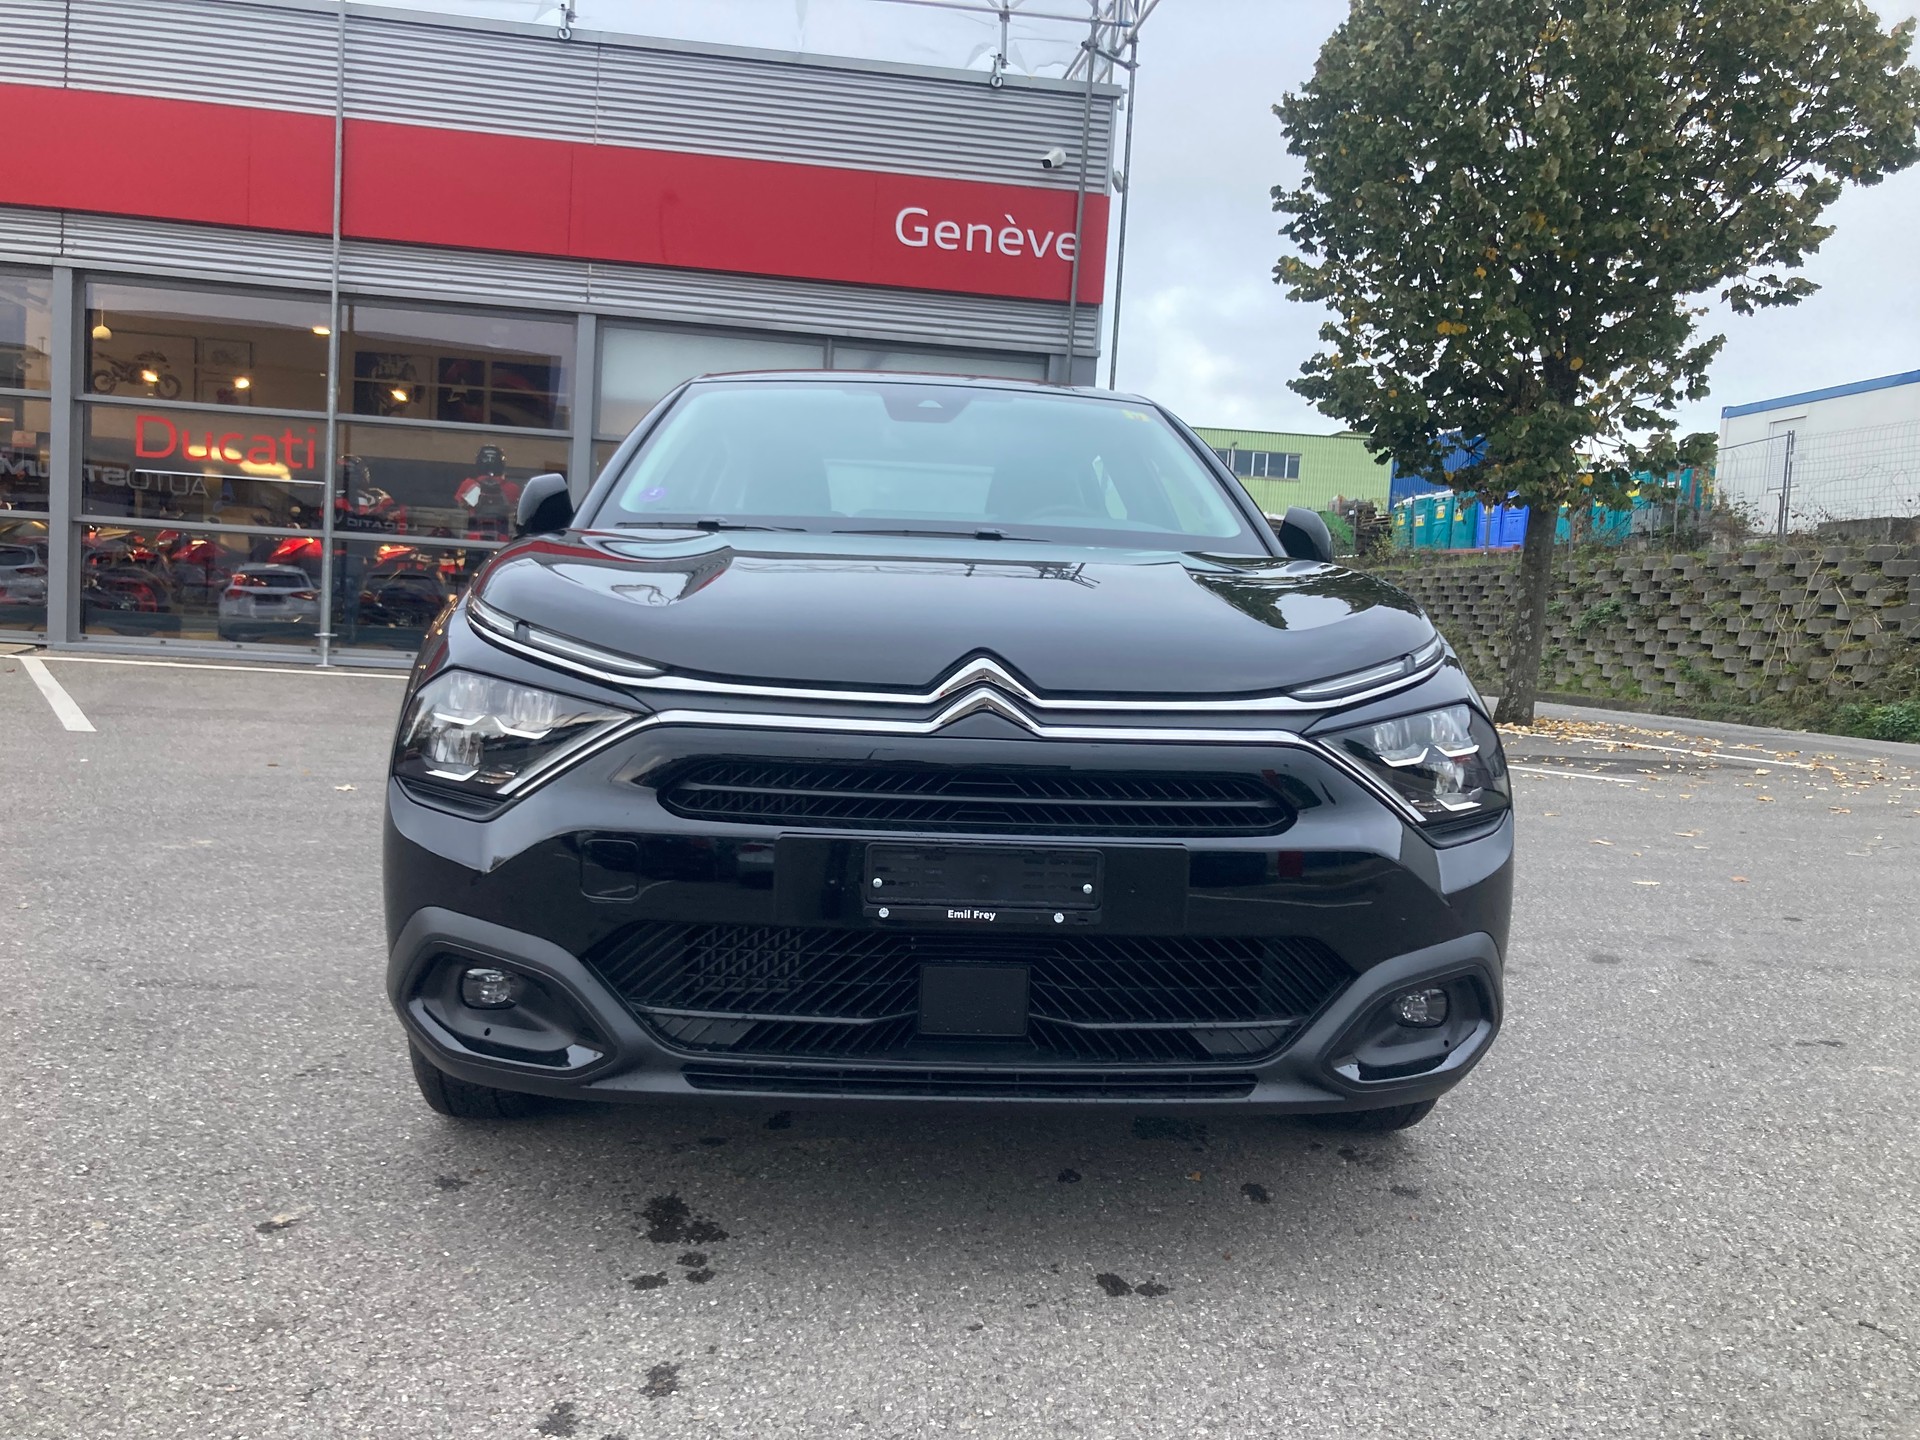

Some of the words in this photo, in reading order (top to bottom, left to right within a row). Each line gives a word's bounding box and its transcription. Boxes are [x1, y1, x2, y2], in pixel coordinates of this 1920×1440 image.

[895, 206, 1080, 262] Genève
[135, 415, 316, 470] Ducati
[947, 909, 971, 919] Emil
[973, 910, 997, 922] Frey
